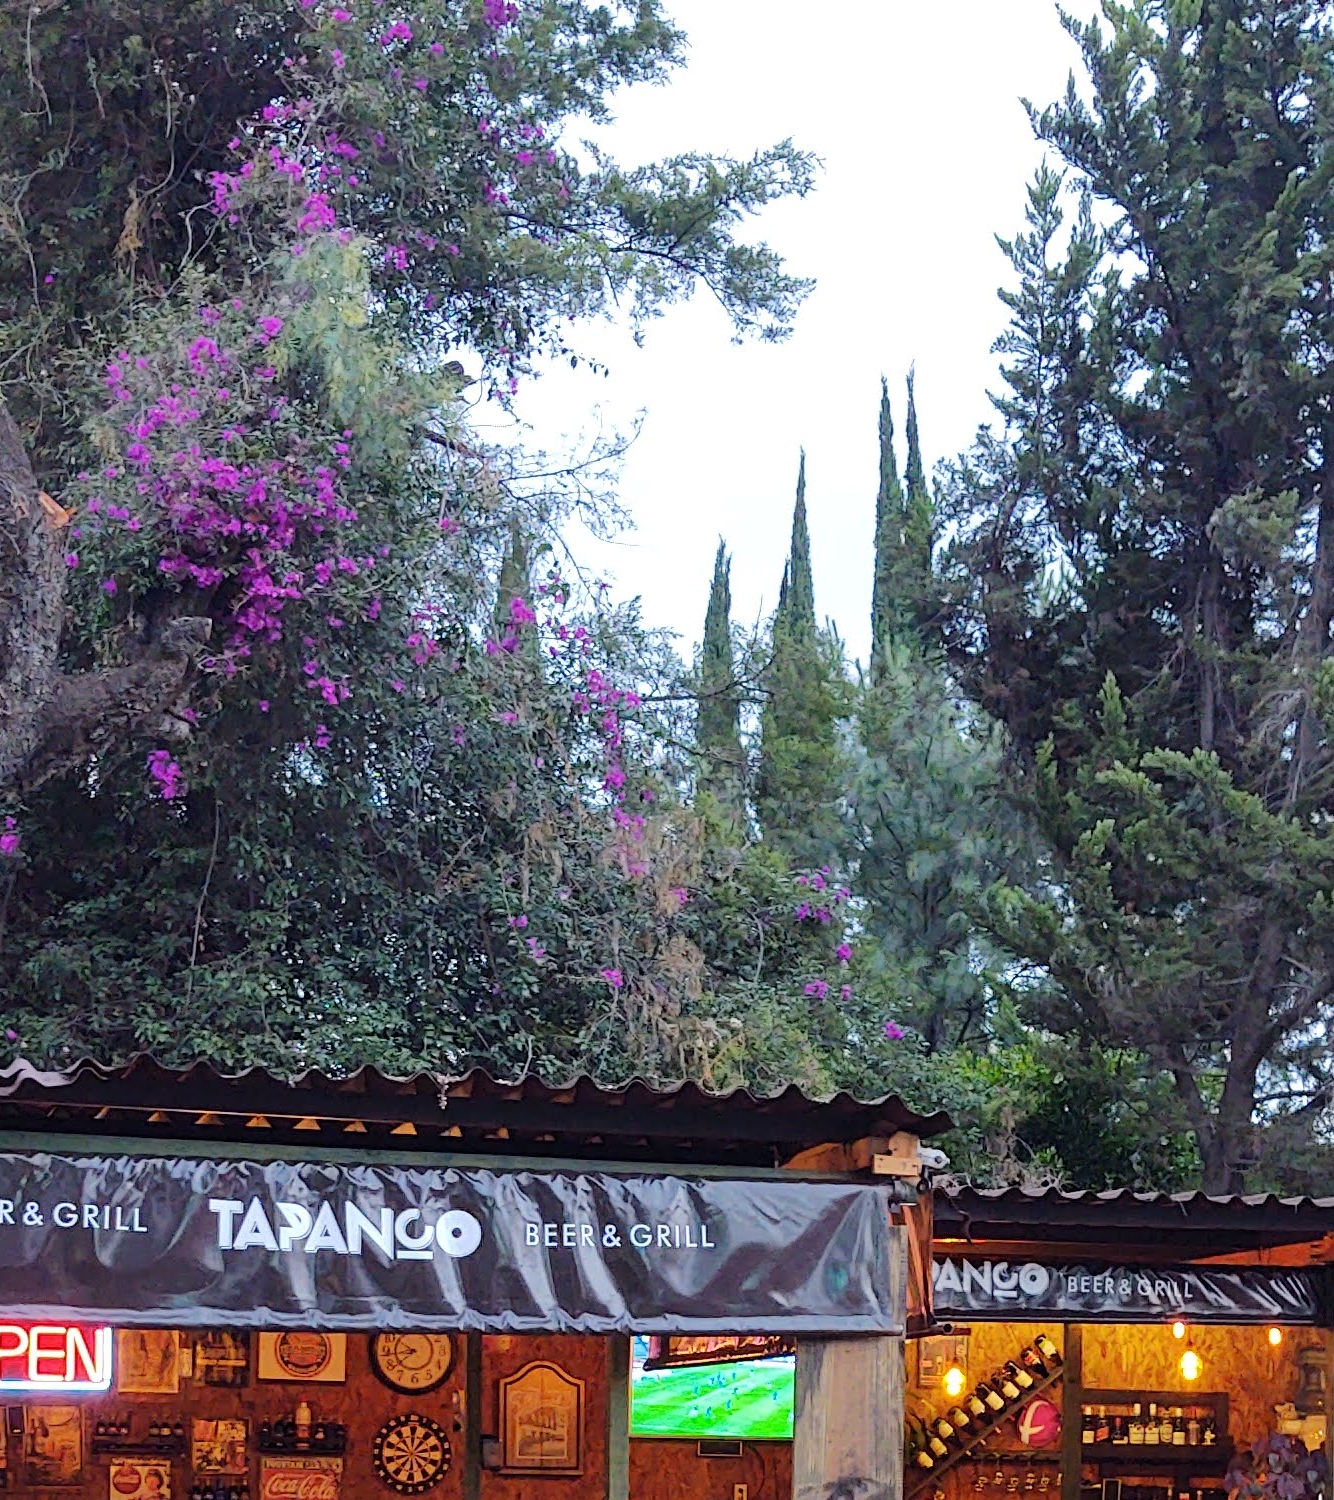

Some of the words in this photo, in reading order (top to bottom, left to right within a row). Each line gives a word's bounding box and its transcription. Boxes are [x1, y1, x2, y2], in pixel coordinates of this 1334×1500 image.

[22, 1201, 44, 1226] &
[53, 1202, 148, 1232] GRILL
[525, 1223, 596, 1248] BEER
[602, 1224, 622, 1248] &
[629, 1223, 716, 1248] GRILL
[1067, 1275, 1115, 1295] BEER
[1119, 1278, 1132, 1296] &
[1136, 1279, 1194, 1300] GRILL
